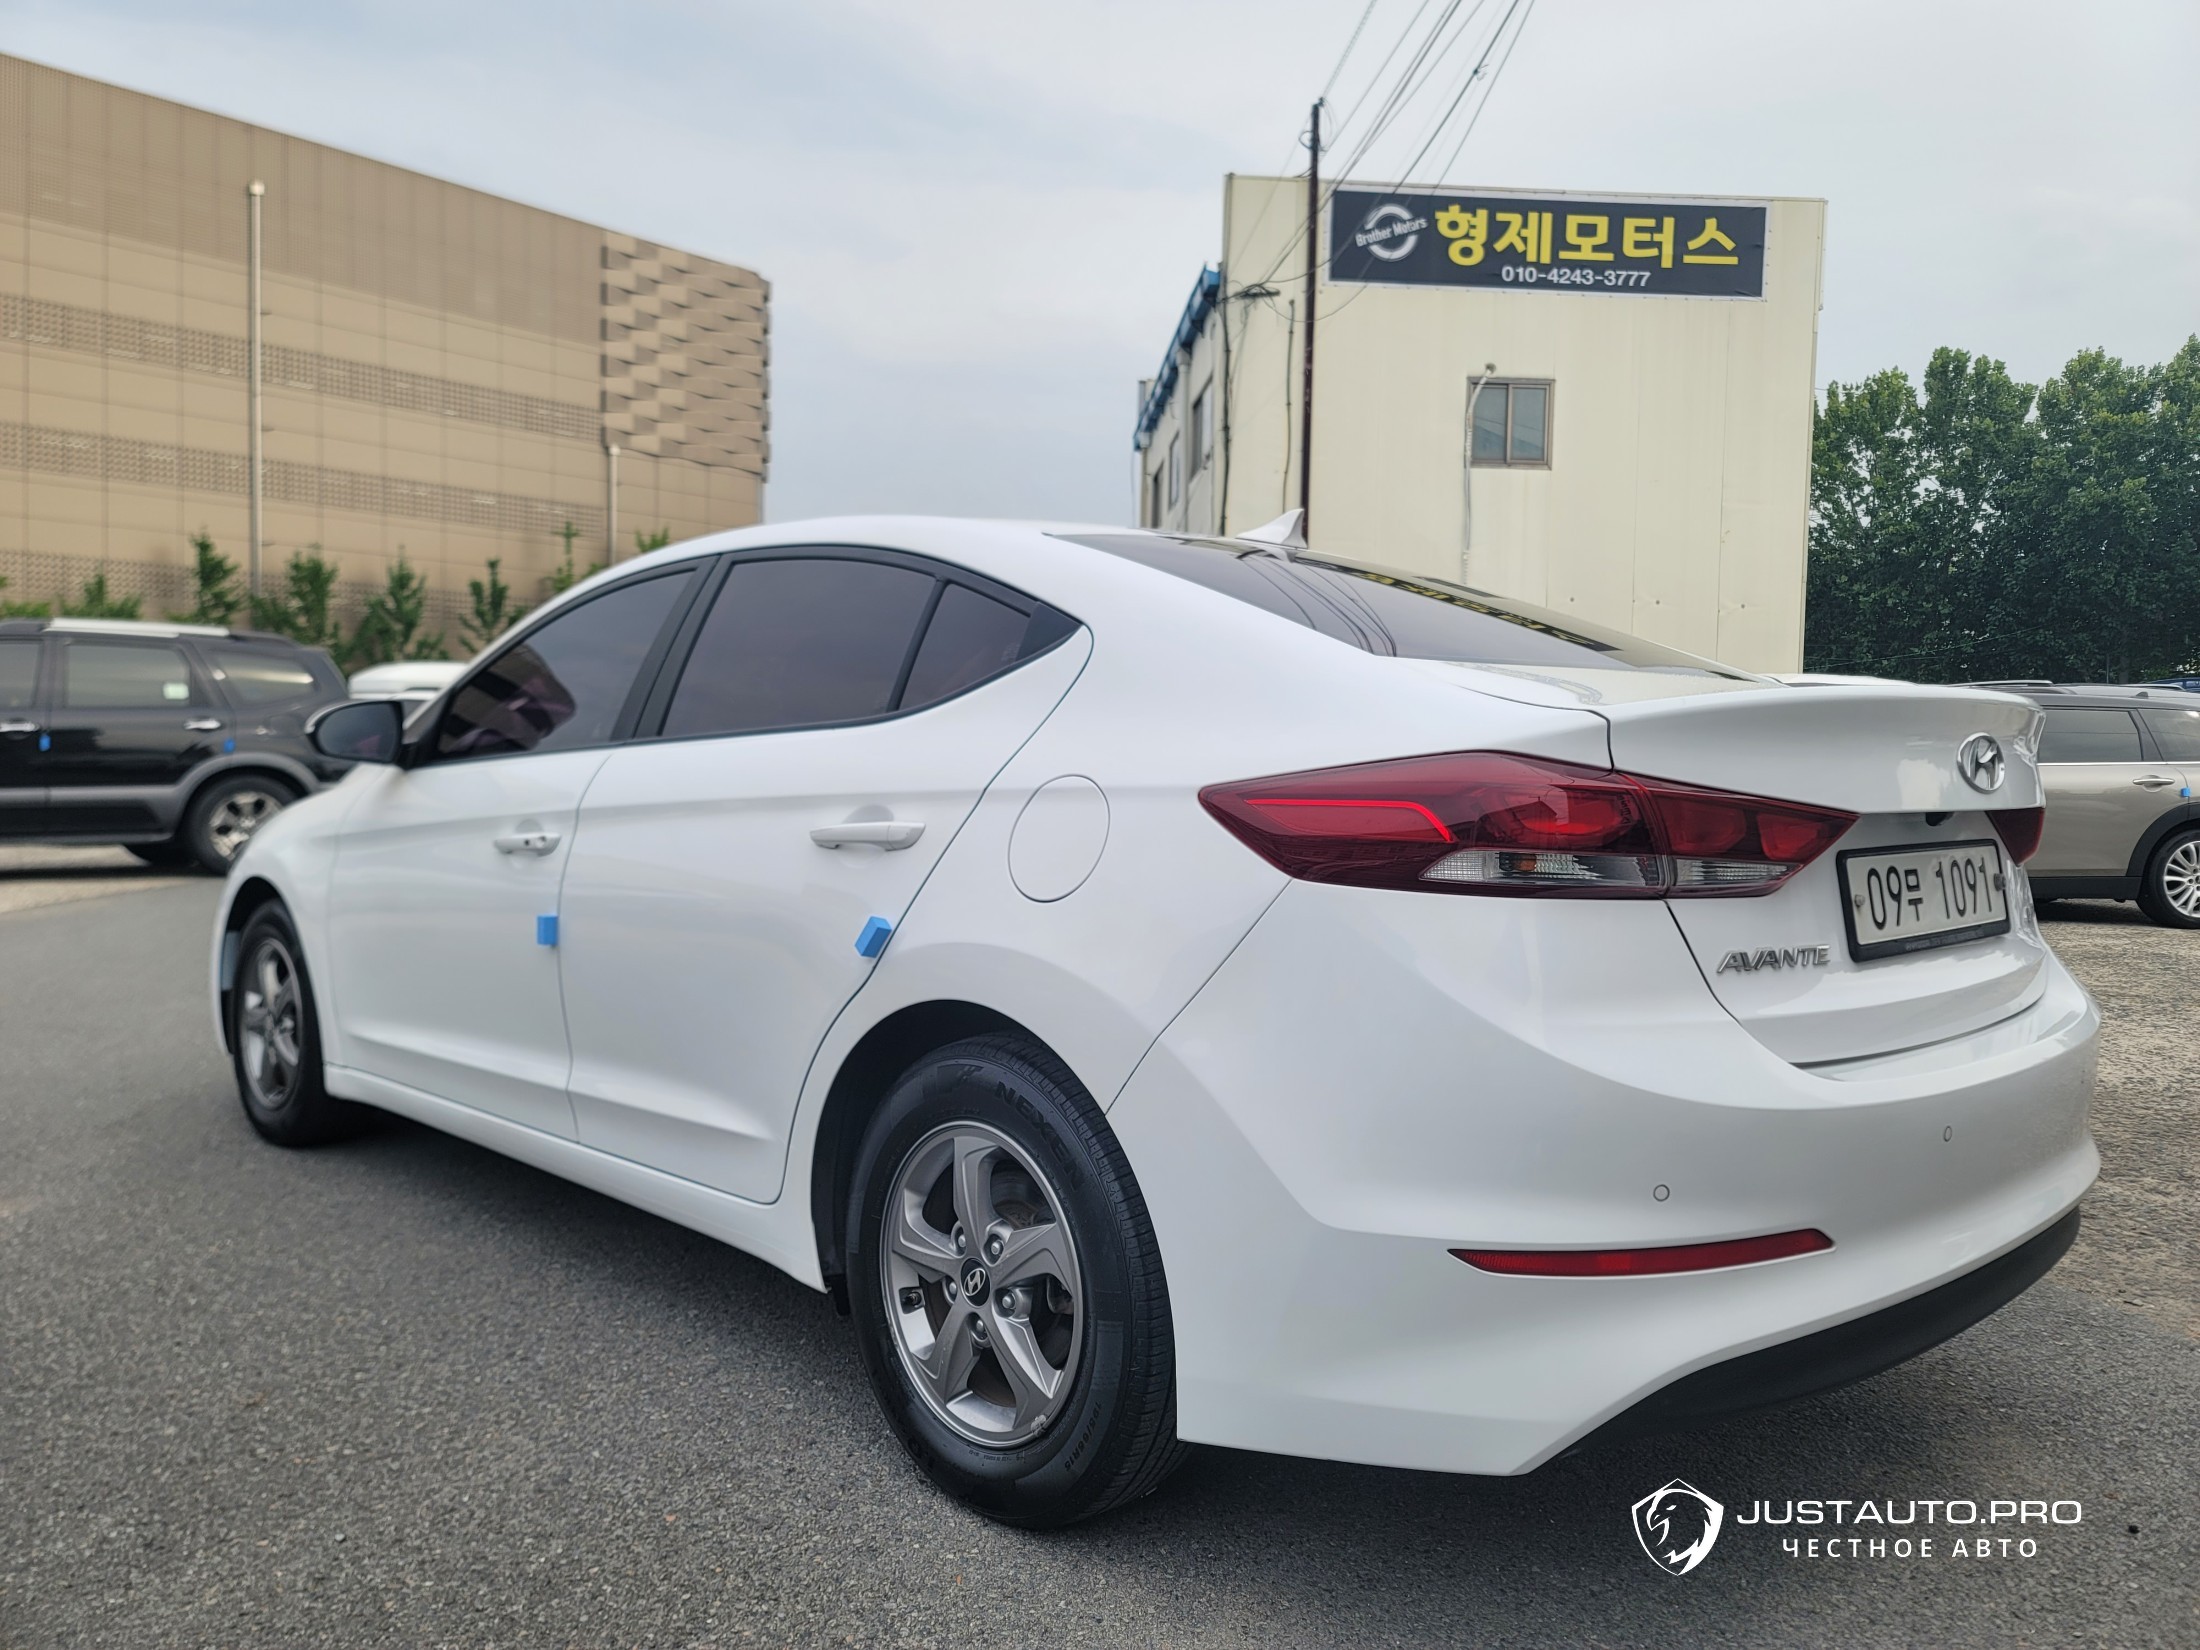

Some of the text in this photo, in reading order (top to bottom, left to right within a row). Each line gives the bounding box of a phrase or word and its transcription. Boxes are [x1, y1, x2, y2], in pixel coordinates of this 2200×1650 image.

[1355, 227, 1393, 247] Brother
[1435, 204, 1739, 268] 형제모터스
[1501, 266, 1651, 287] 010-4243-3777
[1867, 857, 1992, 930] 09무 1091
[1717, 945, 1831, 973] AVANTE
[994, 1081, 1083, 1193] NEXEN
